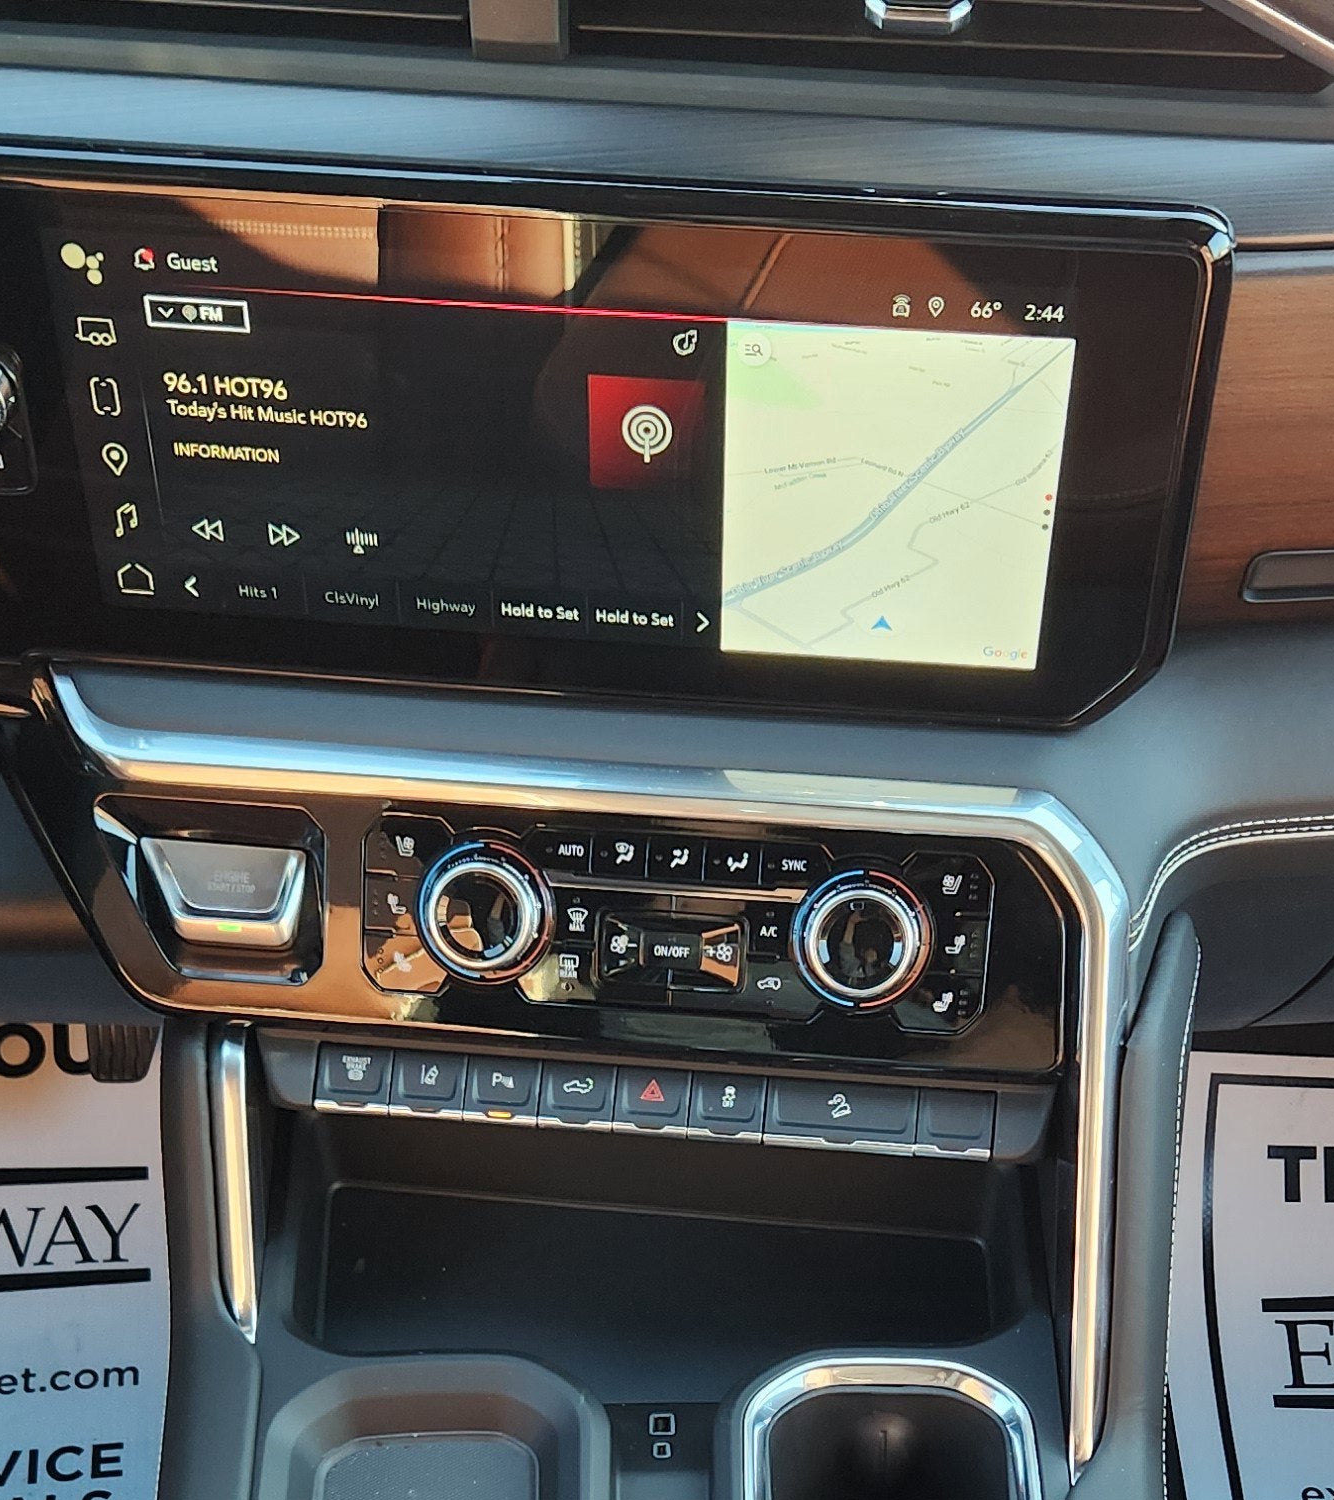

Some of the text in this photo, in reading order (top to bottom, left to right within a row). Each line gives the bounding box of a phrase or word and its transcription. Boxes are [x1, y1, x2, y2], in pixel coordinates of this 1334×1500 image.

[166, 252, 219, 273] Guest
[199, 307, 224, 323] FM
[970, 301, 1065, 323] 66° 2:44
[163, 371, 288, 401] 96.1 HOT96
[166, 398, 368, 429] Today's Hit Music HOT96
[173, 441, 280, 464] INFORMATION
[238, 584, 267, 600] Hits
[416, 597, 477, 617] Highway
[500, 602, 580, 623] Hold to Set
[595, 608, 675, 629] Hold to Set
[982, 645, 1028, 661] Google
[558, 844, 584, 857] AUTO
[781, 860, 807, 872] SYNC
[760, 925, 778, 938] A/C
[654, 944, 690, 958] ON/OFF
